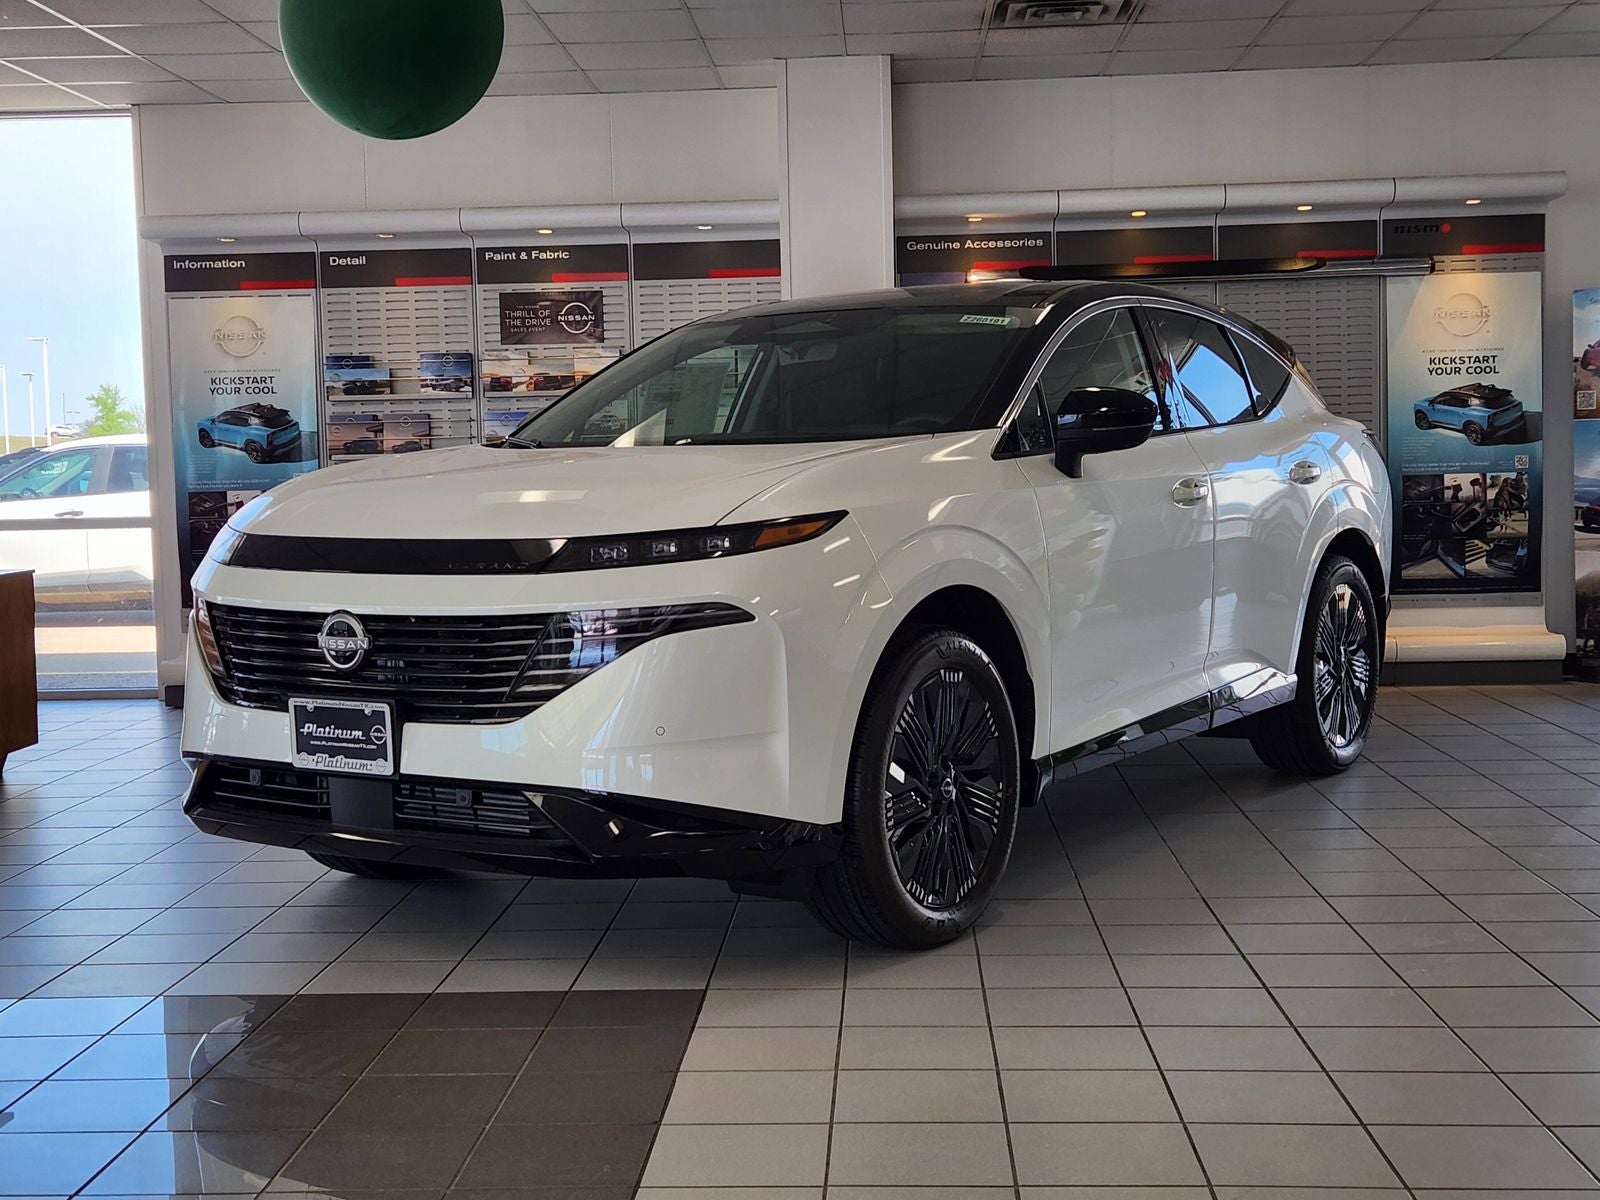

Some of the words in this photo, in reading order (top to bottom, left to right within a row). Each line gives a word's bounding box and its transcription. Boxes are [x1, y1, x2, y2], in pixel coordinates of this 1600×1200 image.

[906, 240, 961, 251] Genuine
[964, 238, 1044, 249] Accessories
[485, 251, 517, 261] Paint
[519, 251, 528, 260] &
[531, 249, 570, 260] Fabric
[173, 258, 246, 270] Information
[329, 255, 366, 267] Detail
[505, 310, 535, 318] THRILL
[538, 309, 551, 317] OF
[1433, 309, 1490, 319] NISSAN
[525, 318, 552, 326] DRIVE
[213, 330, 266, 340] NISSAN
[1429, 355, 1498, 366] KICKSTART
[1427, 366, 1462, 376] YOUR
[1465, 365, 1500, 375] COOL
[210, 376, 275, 386] KICKSTART
[209, 386, 241, 396] YOUR
[245, 386, 278, 395] COOL
[318, 638, 368, 649] NISSAN
[299, 723, 367, 740] Platinum
[315, 754, 372, 771] Platinum
